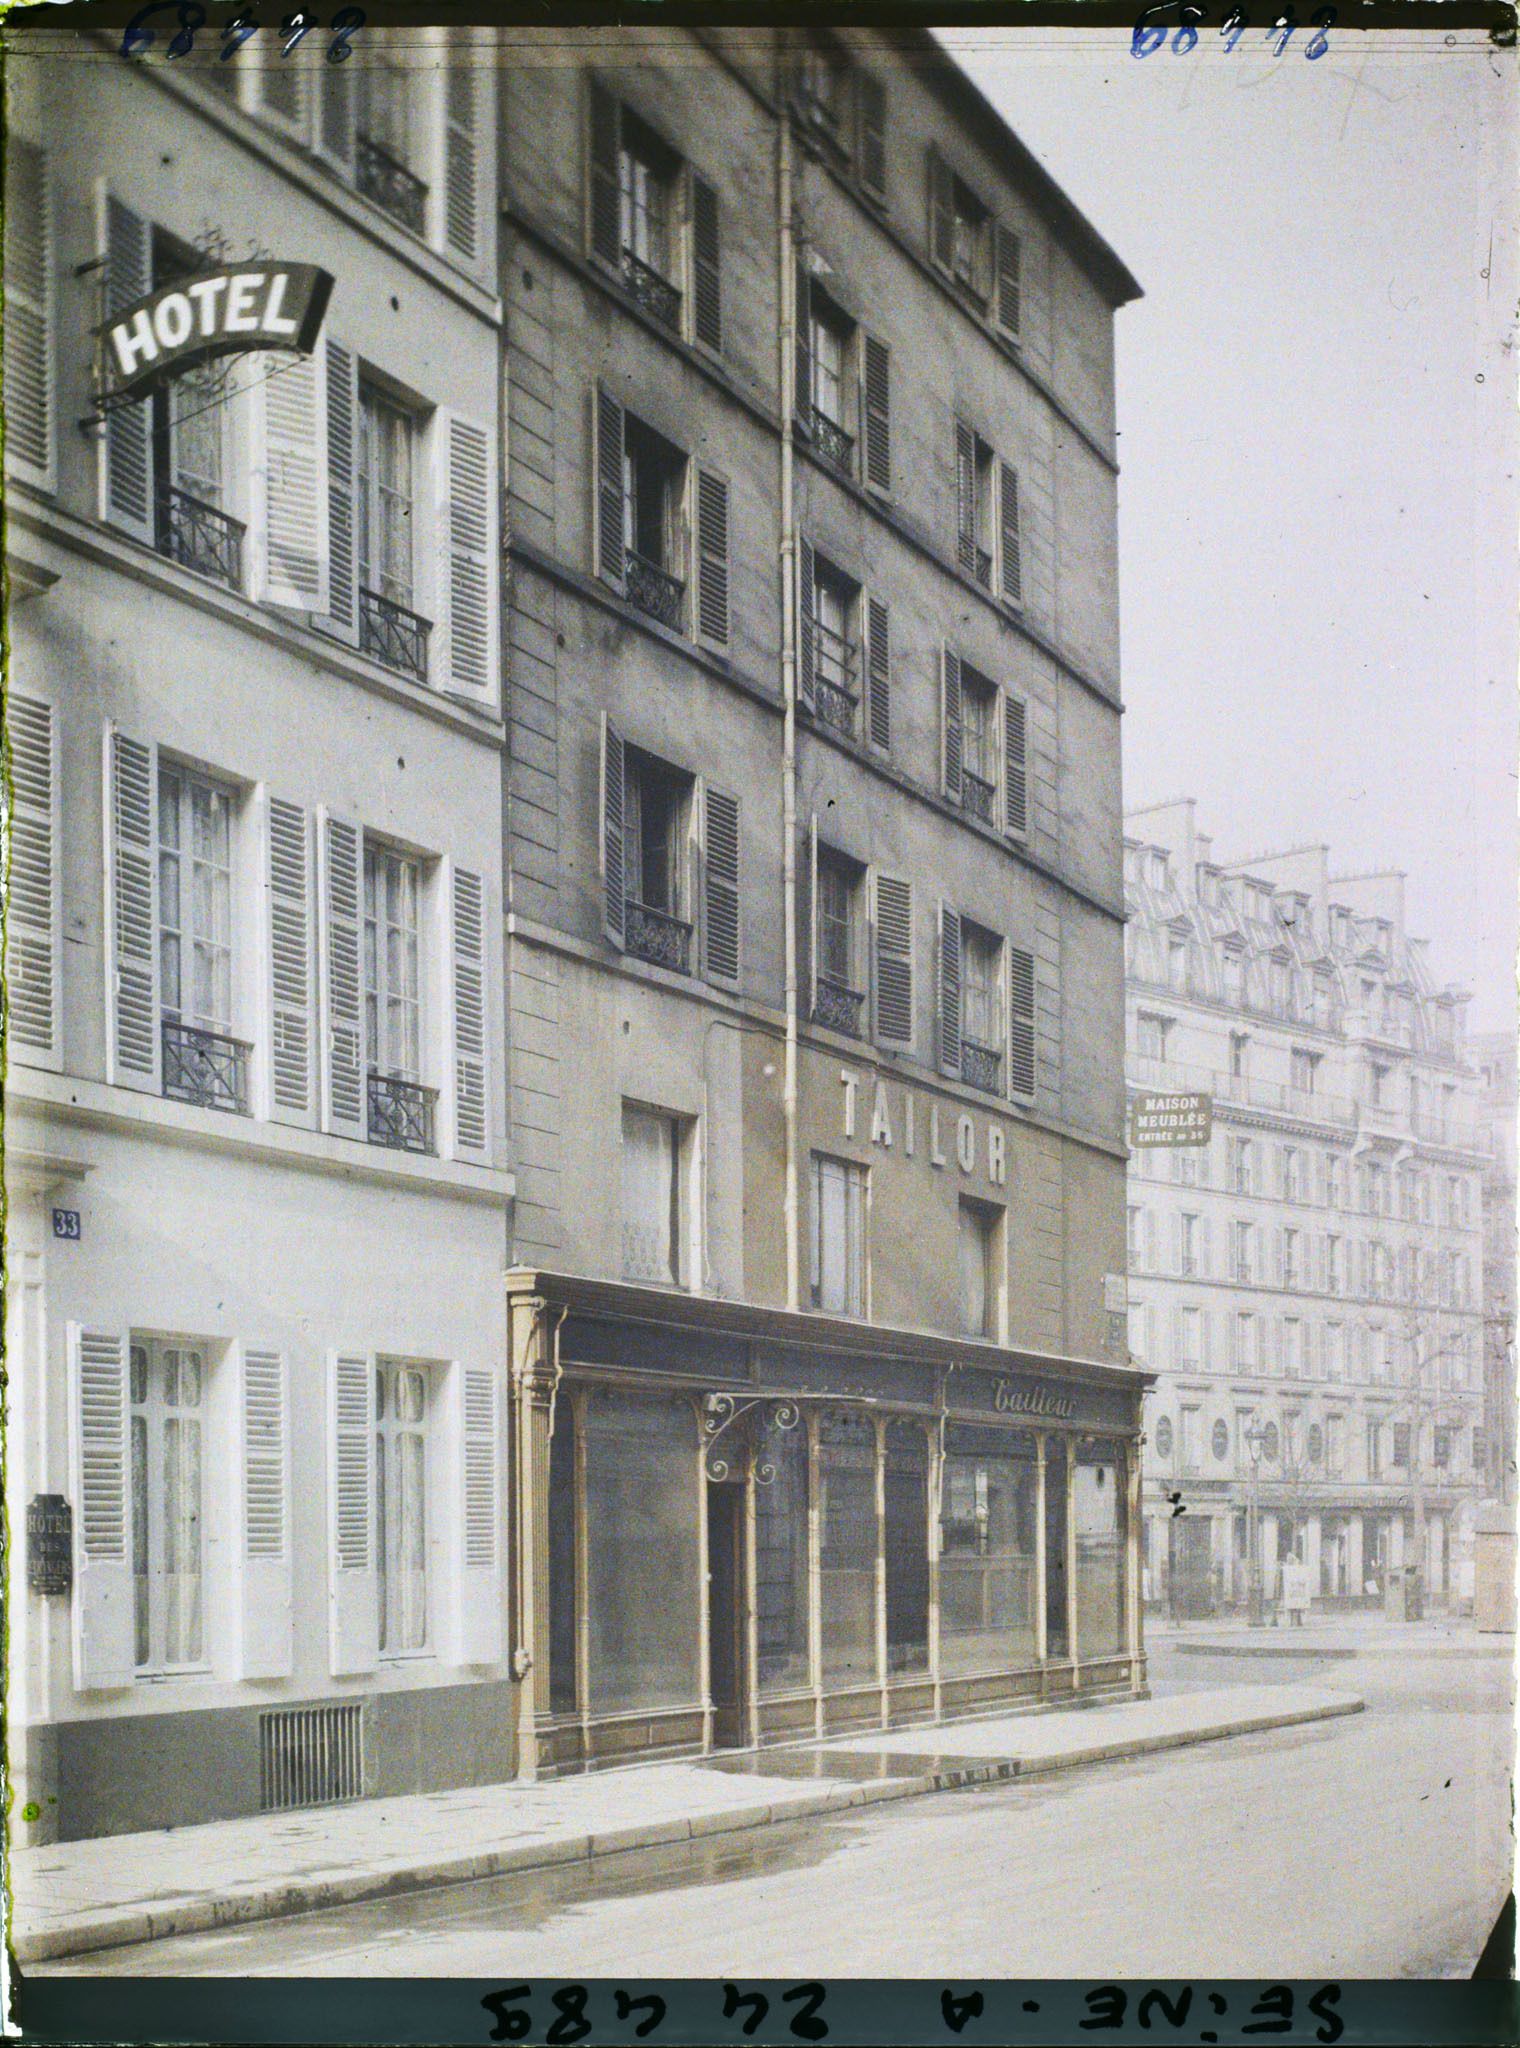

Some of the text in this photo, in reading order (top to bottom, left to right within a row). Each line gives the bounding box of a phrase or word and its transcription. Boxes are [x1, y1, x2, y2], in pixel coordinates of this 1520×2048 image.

[111, 273, 298, 375] HOTEL
[1138, 1112, 1207, 1128] MEUBLÉE
[1145, 1097, 1199, 1111] MAISON
[841, 1069, 1006, 1184] TAILOR
[56, 1211, 78, 1236] 33
[992, 1377, 1078, 1417] Tailleur
[940, 1988, 984, 2031] A
